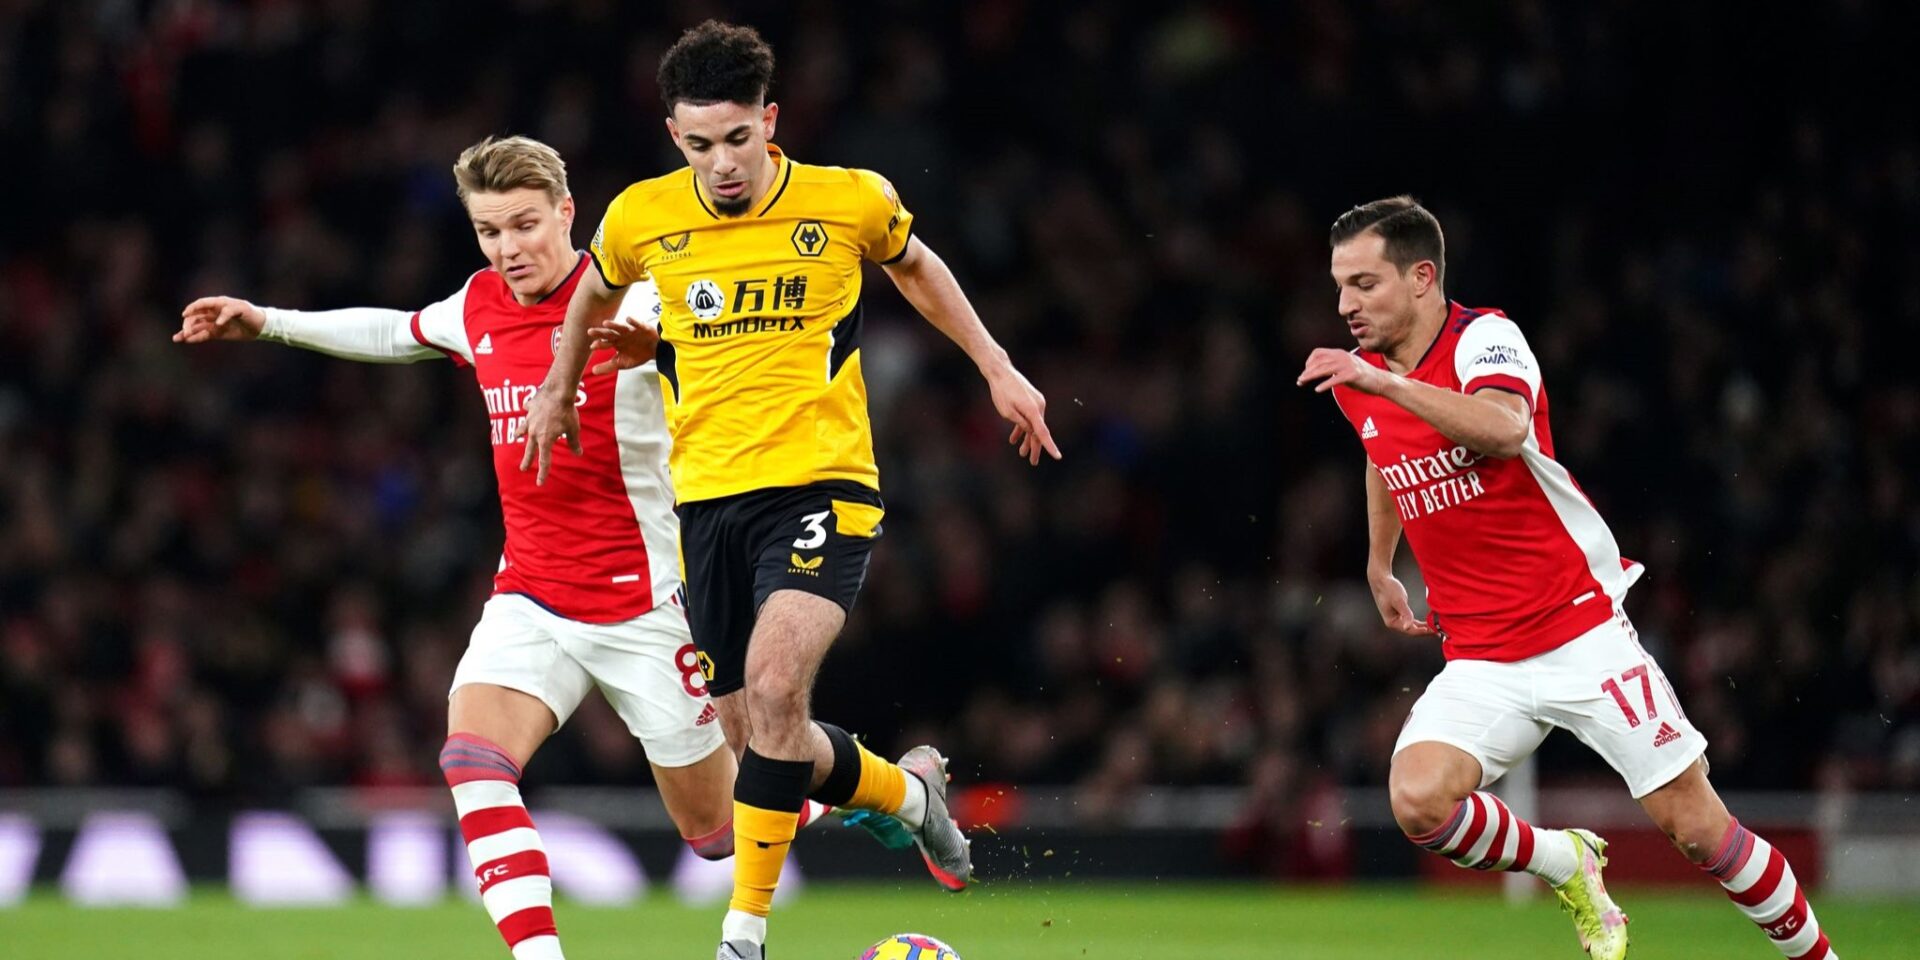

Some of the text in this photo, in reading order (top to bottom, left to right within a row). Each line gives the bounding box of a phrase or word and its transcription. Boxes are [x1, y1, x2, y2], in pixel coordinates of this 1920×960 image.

[731, 275, 808, 314] 万博
[1396, 470, 1486, 521] FLY BETTER
[792, 509, 831, 550] 3
[674, 643, 709, 698] 8
[1600, 664, 1658, 729] 17
[1653, 731, 1682, 748] adidas
